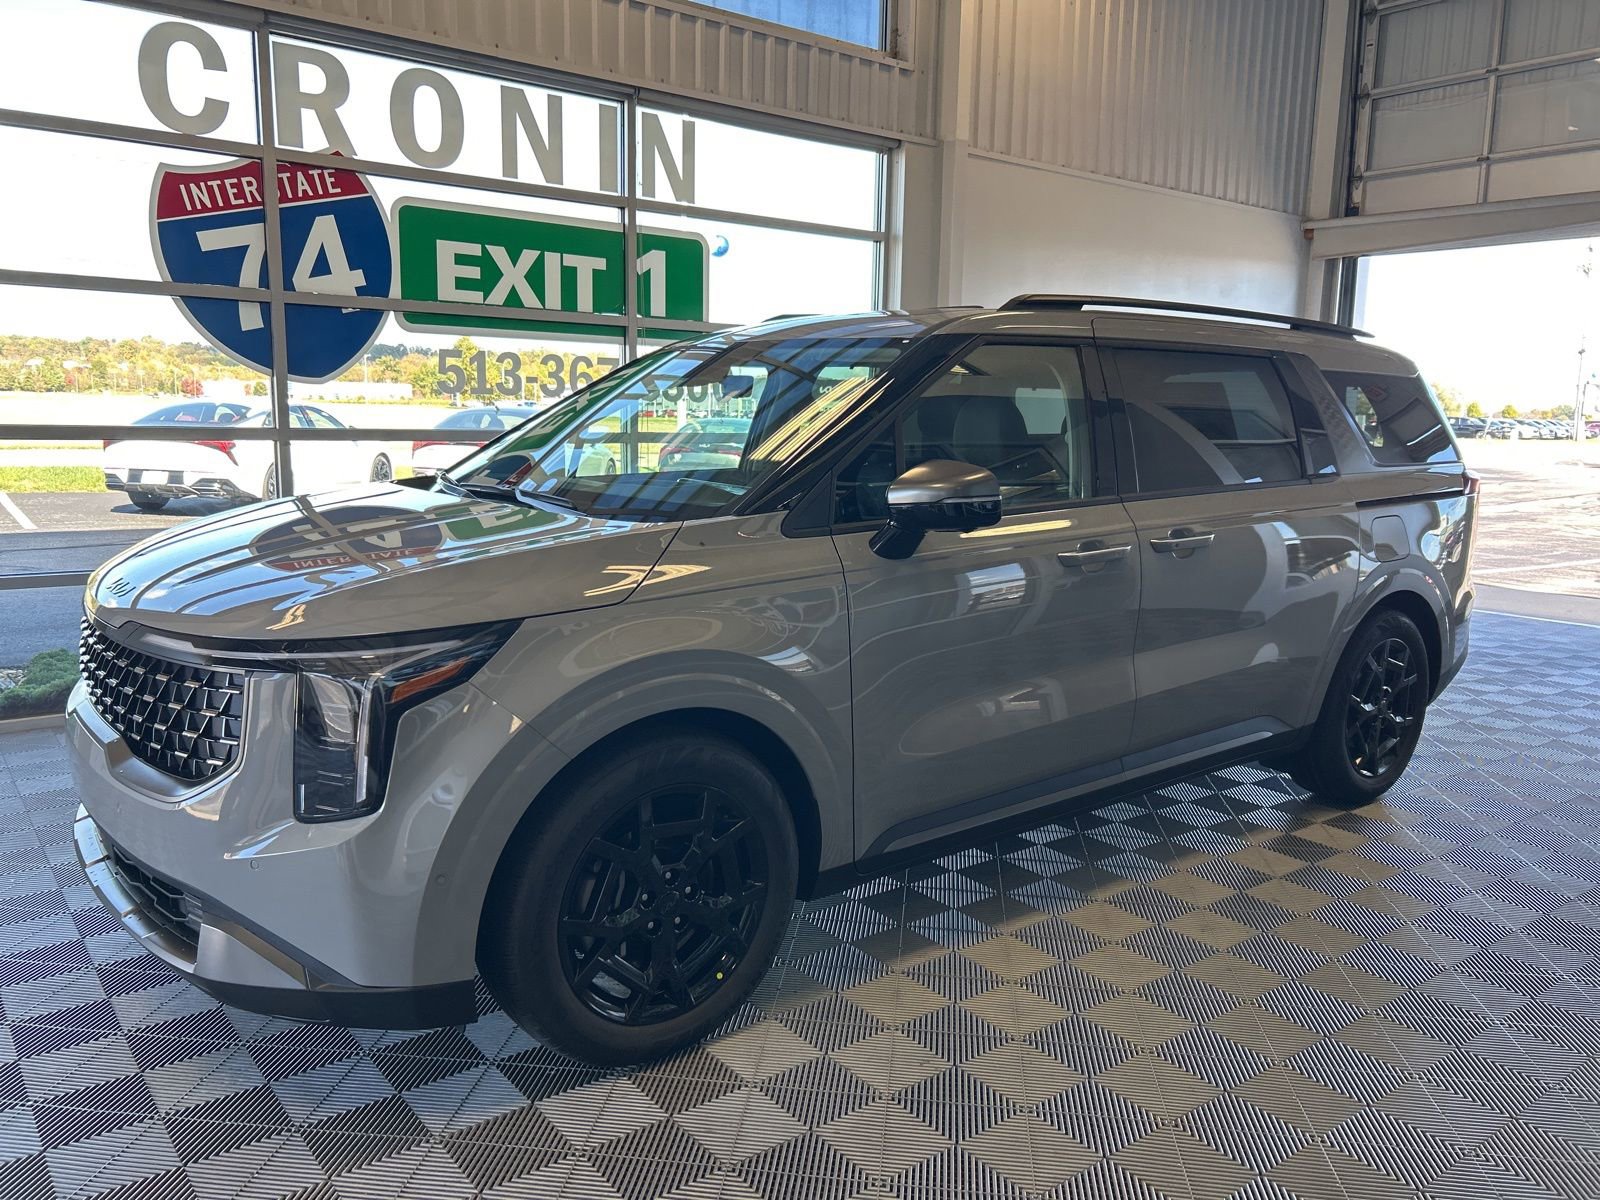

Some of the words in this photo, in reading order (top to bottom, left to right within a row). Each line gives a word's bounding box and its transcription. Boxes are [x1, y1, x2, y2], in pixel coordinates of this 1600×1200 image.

[138, 21, 695, 204] CRONIN
[179, 168, 342, 211] INTERTATE
[196, 214, 367, 332] 74
[436, 239, 607, 313] EXIT
[636, 249, 667, 318] 1
